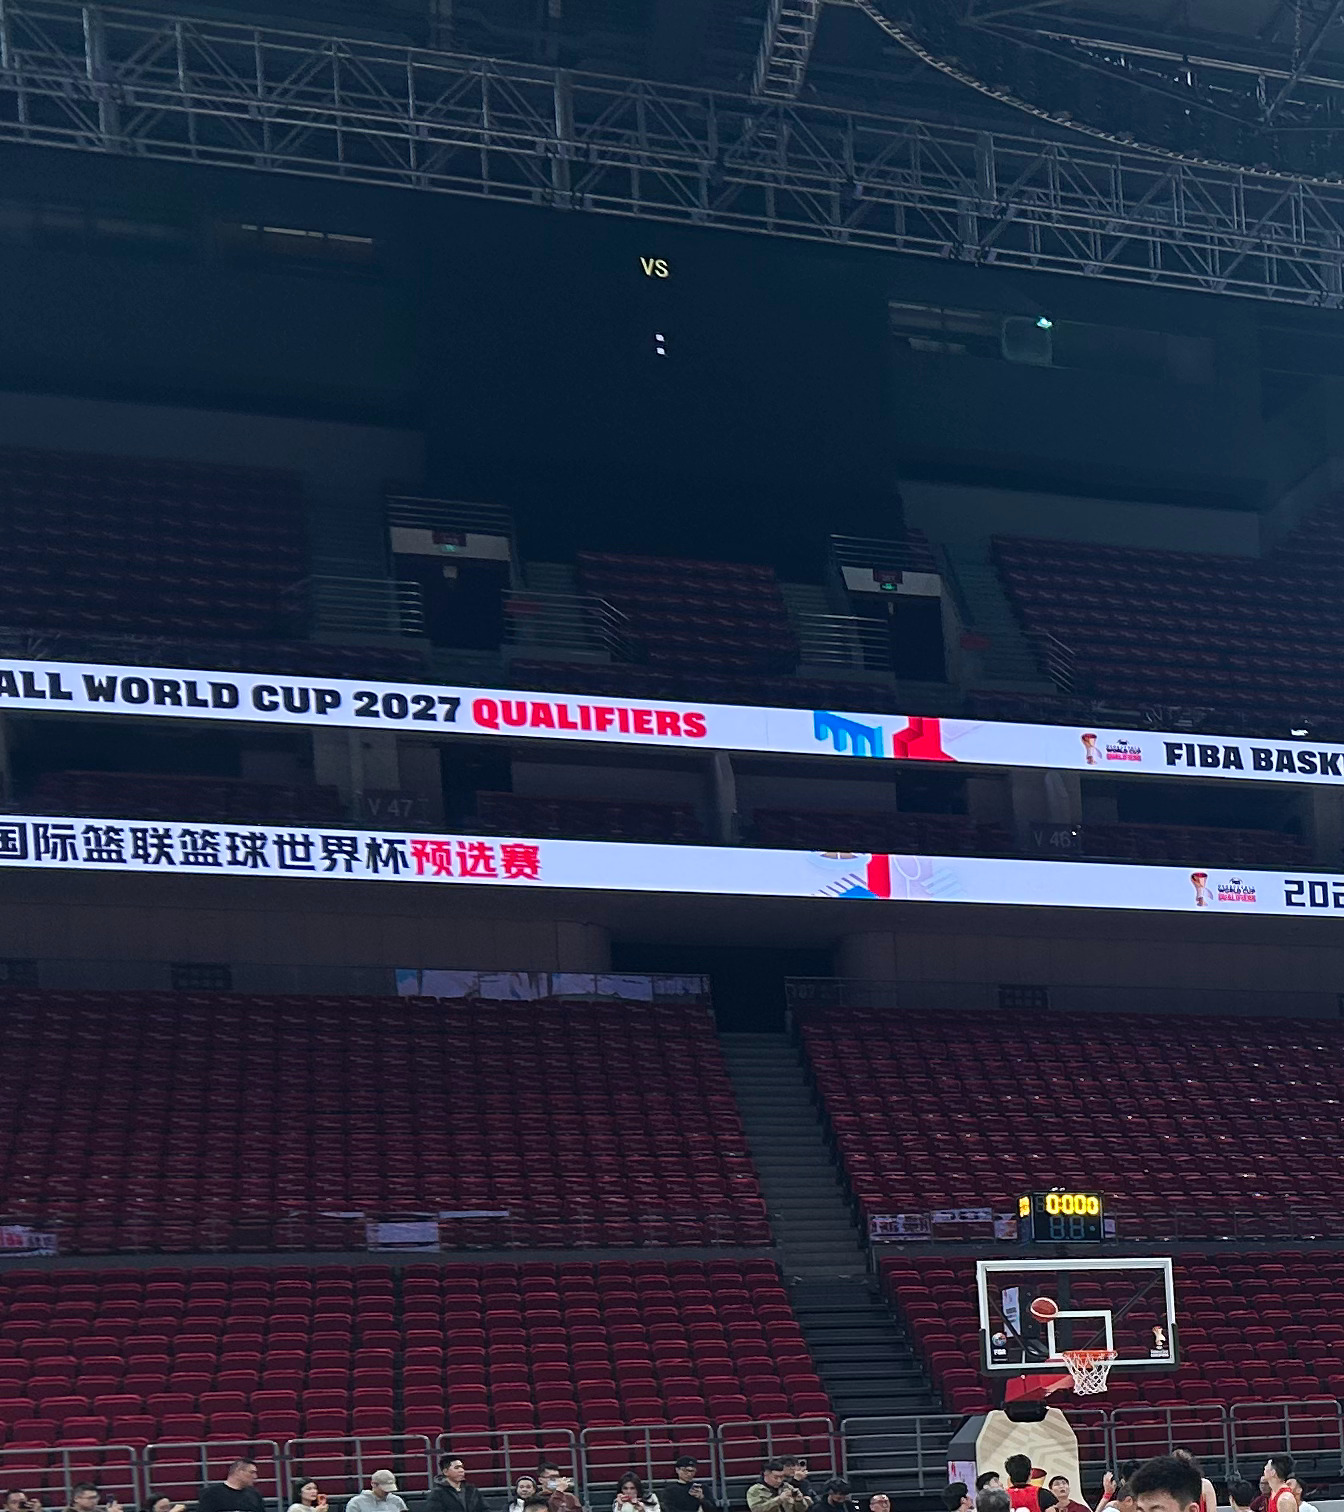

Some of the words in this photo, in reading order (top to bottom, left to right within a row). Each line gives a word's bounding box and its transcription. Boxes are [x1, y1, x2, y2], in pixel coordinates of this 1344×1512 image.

[640, 257, 670, 279] VS
[82, 674, 239, 709] WORLD
[251, 685, 341, 715] CUP
[353, 691, 461, 722] 2027
[472, 698, 707, 738] QUALIFIERS
[1163, 741, 1244, 771] FIBA
[367, 798, 381, 815] V
[387, 799, 414, 817] 47
[1034, 831, 1043, 847] V
[1050, 831, 1071, 848] 46
